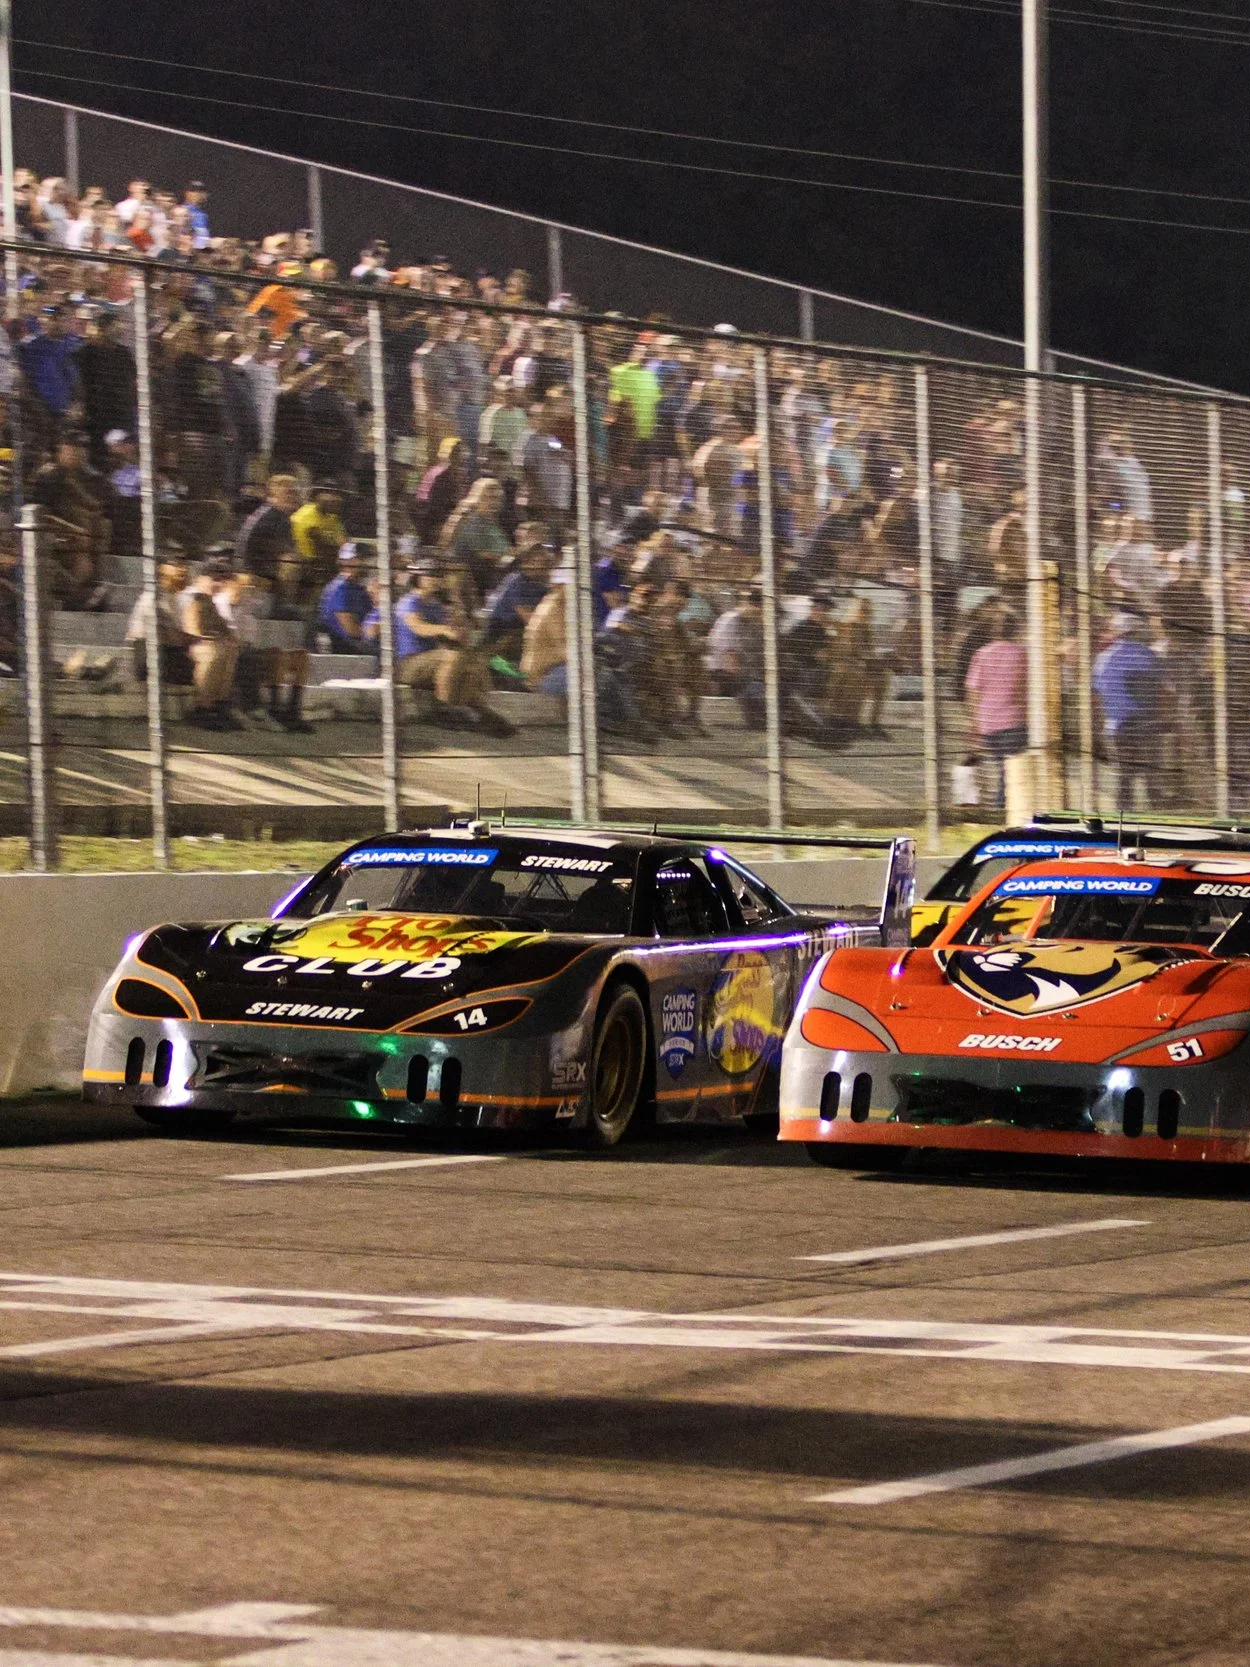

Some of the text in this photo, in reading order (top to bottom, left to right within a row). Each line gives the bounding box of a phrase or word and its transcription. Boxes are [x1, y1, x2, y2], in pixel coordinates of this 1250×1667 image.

[349, 852, 490, 864] CAMPING WORLD
[984, 844, 1053, 853] CAMPING
[521, 855, 613, 873] STEWART
[1003, 880, 1153, 891] CAMPING WORLD
[328, 927, 497, 957] Shops
[242, 955, 463, 979] CLUB
[245, 1002, 365, 1021] STEWART
[663, 993, 695, 1011] CAMPING
[453, 1007, 488, 1030] 14
[662, 1011, 694, 1032] WORLD
[958, 1034, 1063, 1052] BUSCH
[1166, 1038, 1204, 1062] 51
[552, 1061, 586, 1083] SRX
